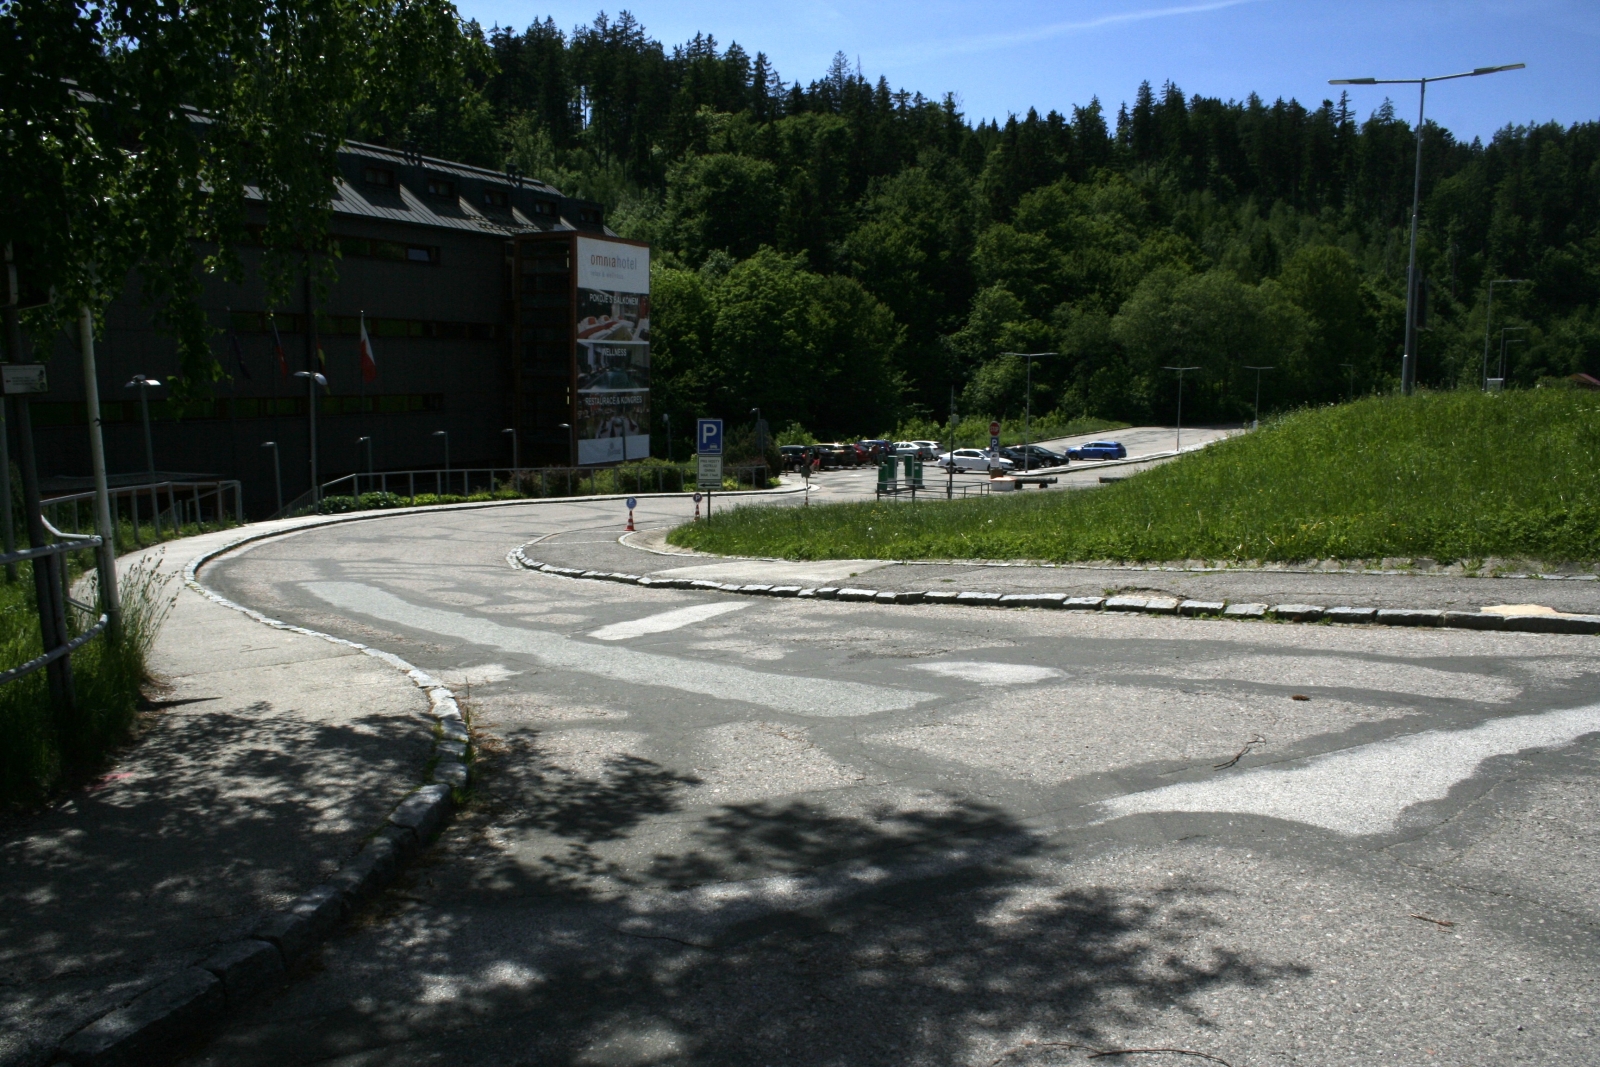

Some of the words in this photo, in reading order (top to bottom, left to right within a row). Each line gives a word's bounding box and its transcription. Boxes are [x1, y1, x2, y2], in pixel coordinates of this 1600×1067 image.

[602, 348, 627, 357] WELLNESS
[585, 396, 616, 406] RESTAURACE
[616, 397, 620, 405] &
[620, 395, 643, 405] KONGRES
[703, 423, 717, 444] P
[992, 439, 997, 448] P
